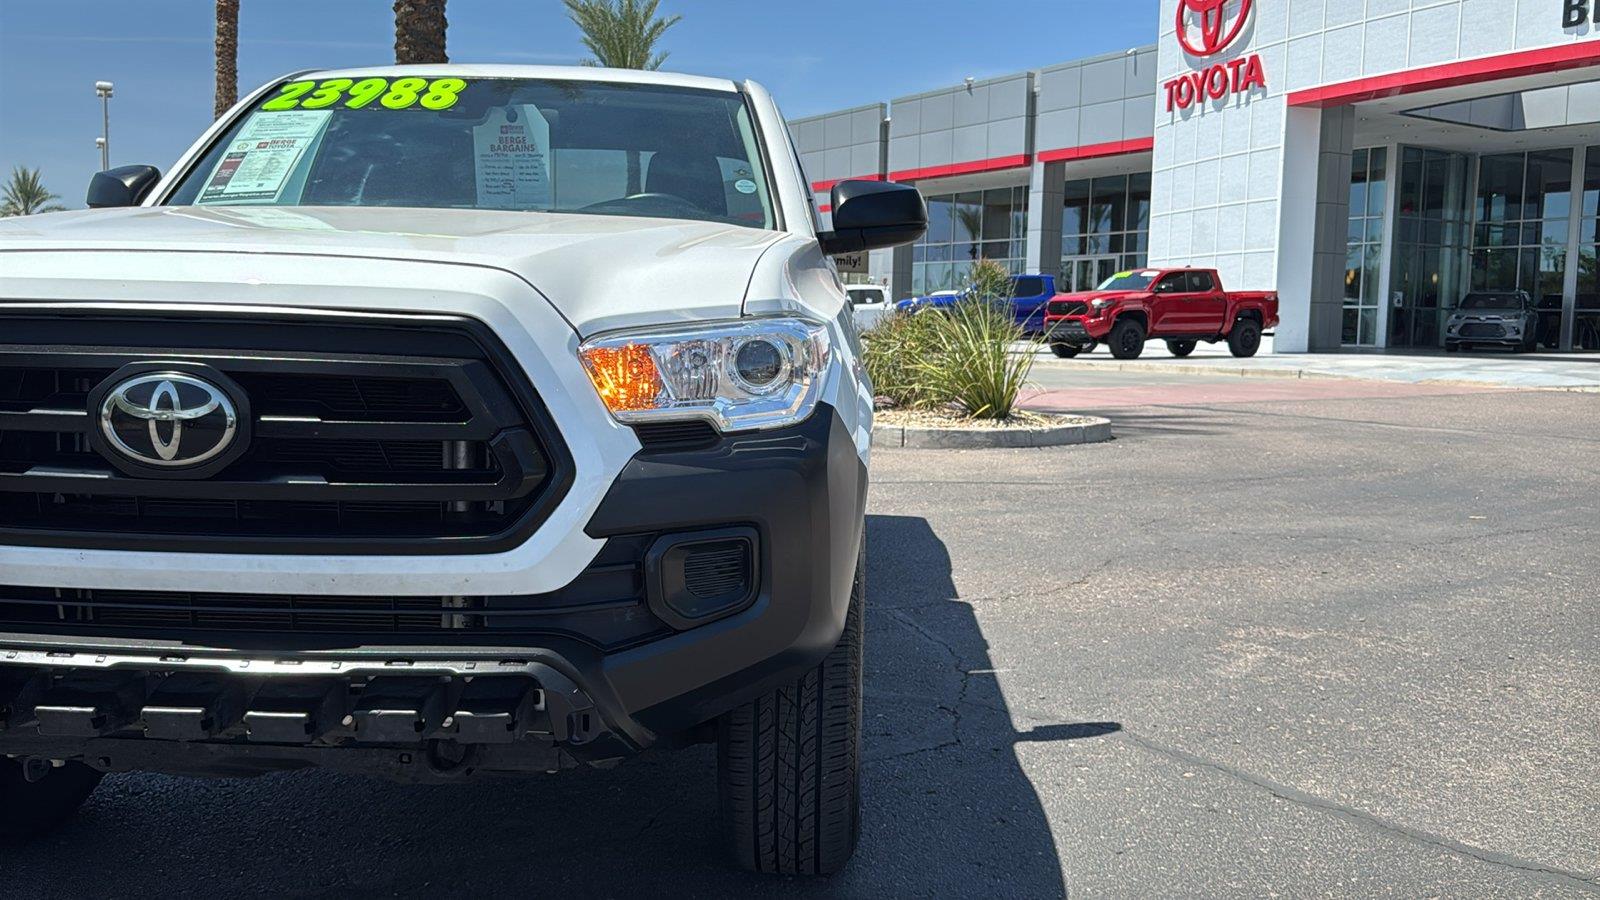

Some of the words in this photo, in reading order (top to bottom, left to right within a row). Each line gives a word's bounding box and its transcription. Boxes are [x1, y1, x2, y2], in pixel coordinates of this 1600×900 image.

[1163, 53, 1266, 112] TOYOTA
[262, 77, 467, 110] 23988
[498, 136, 528, 144] BERGE
[490, 144, 535, 152] BARGAINS
[834, 256, 861, 268] mily!
